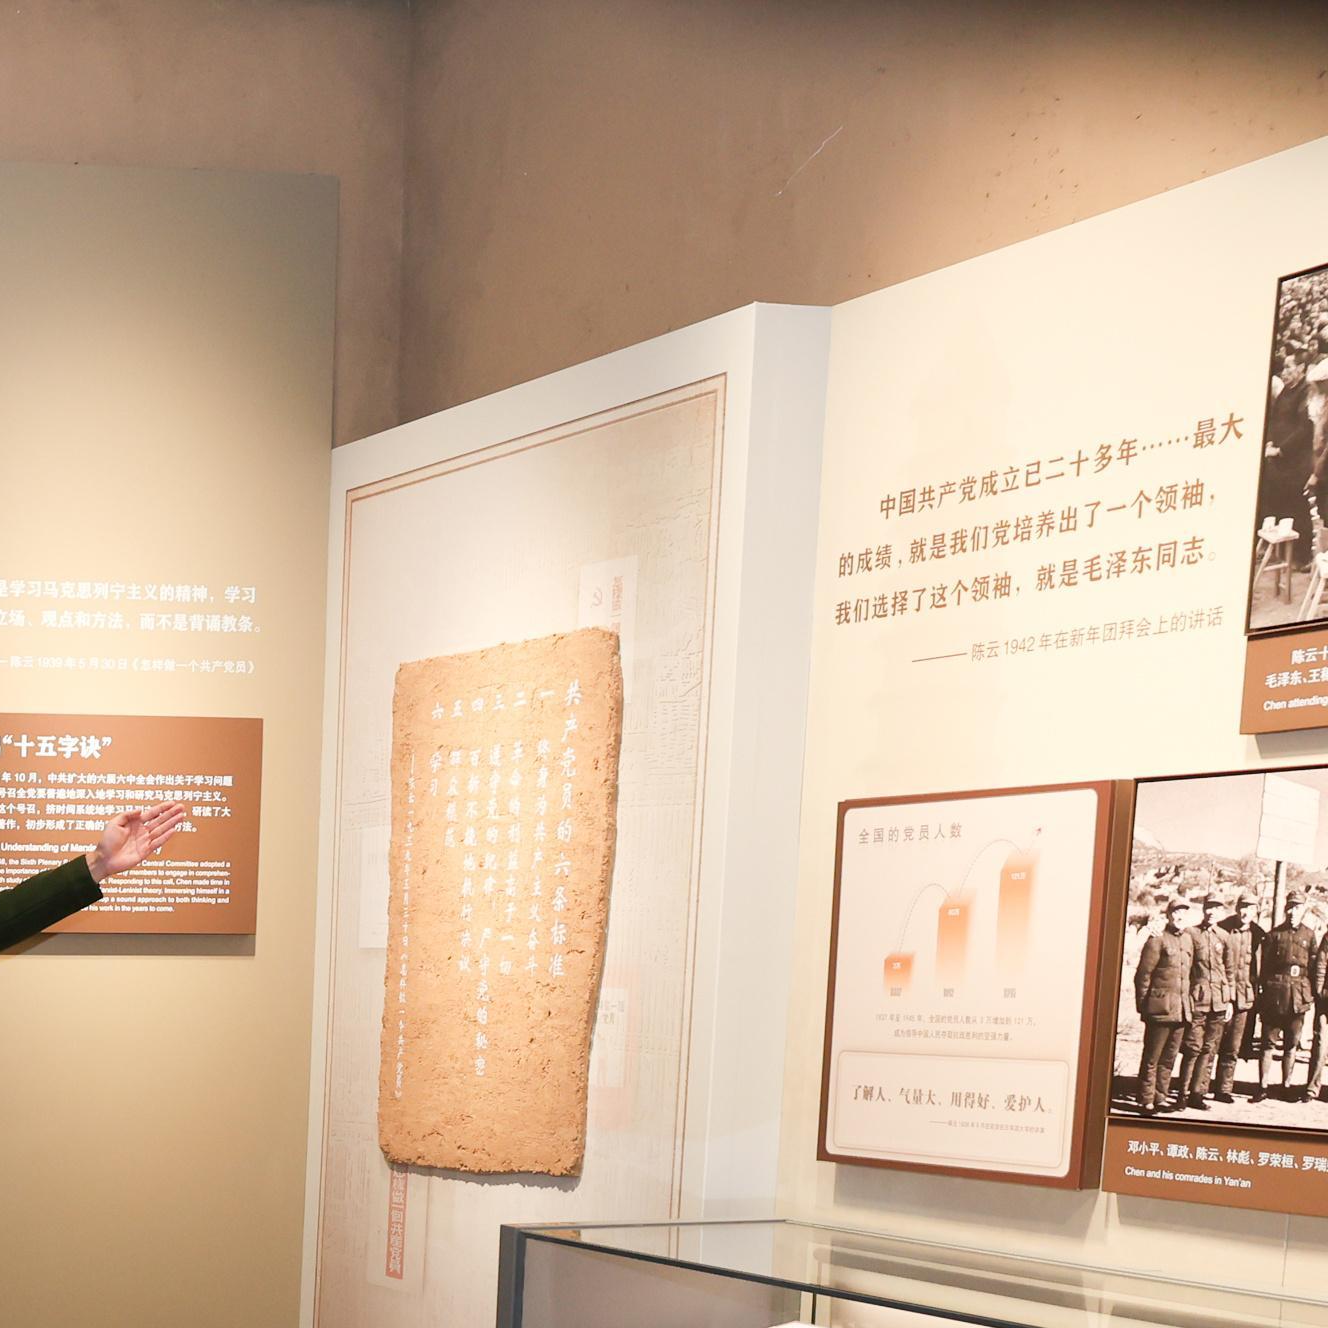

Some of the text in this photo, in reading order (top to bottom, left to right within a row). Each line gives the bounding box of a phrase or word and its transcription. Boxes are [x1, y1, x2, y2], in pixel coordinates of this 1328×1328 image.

[879, 413, 1244, 521] 中国共产党成立已二十多年……最大
[838, 478, 1216, 577] 的成绩，就是我们党培养出了一个领袖，
[835, 536, 1217, 626] 我们选择了这个领袖，就是毛泽东同志。
[1264, 700, 1287, 711] Chen
[548, 678, 582, 978] 共产党员的六条标准
[858, 824, 962, 845] 全国的党员人数
[1, 842, 58, 852] Understanding
[61, 843, 69, 852] of
[38, 859, 61, 867] Plenary
[200, 860, 225, 868] adopted
[1127, 1140, 1328, 1172] 邓小平、谭政、陈云、林彪、罗荣桓、罗瑞
[1125, 1166, 1251, 1188] Chen and his comrades in Yan'an
